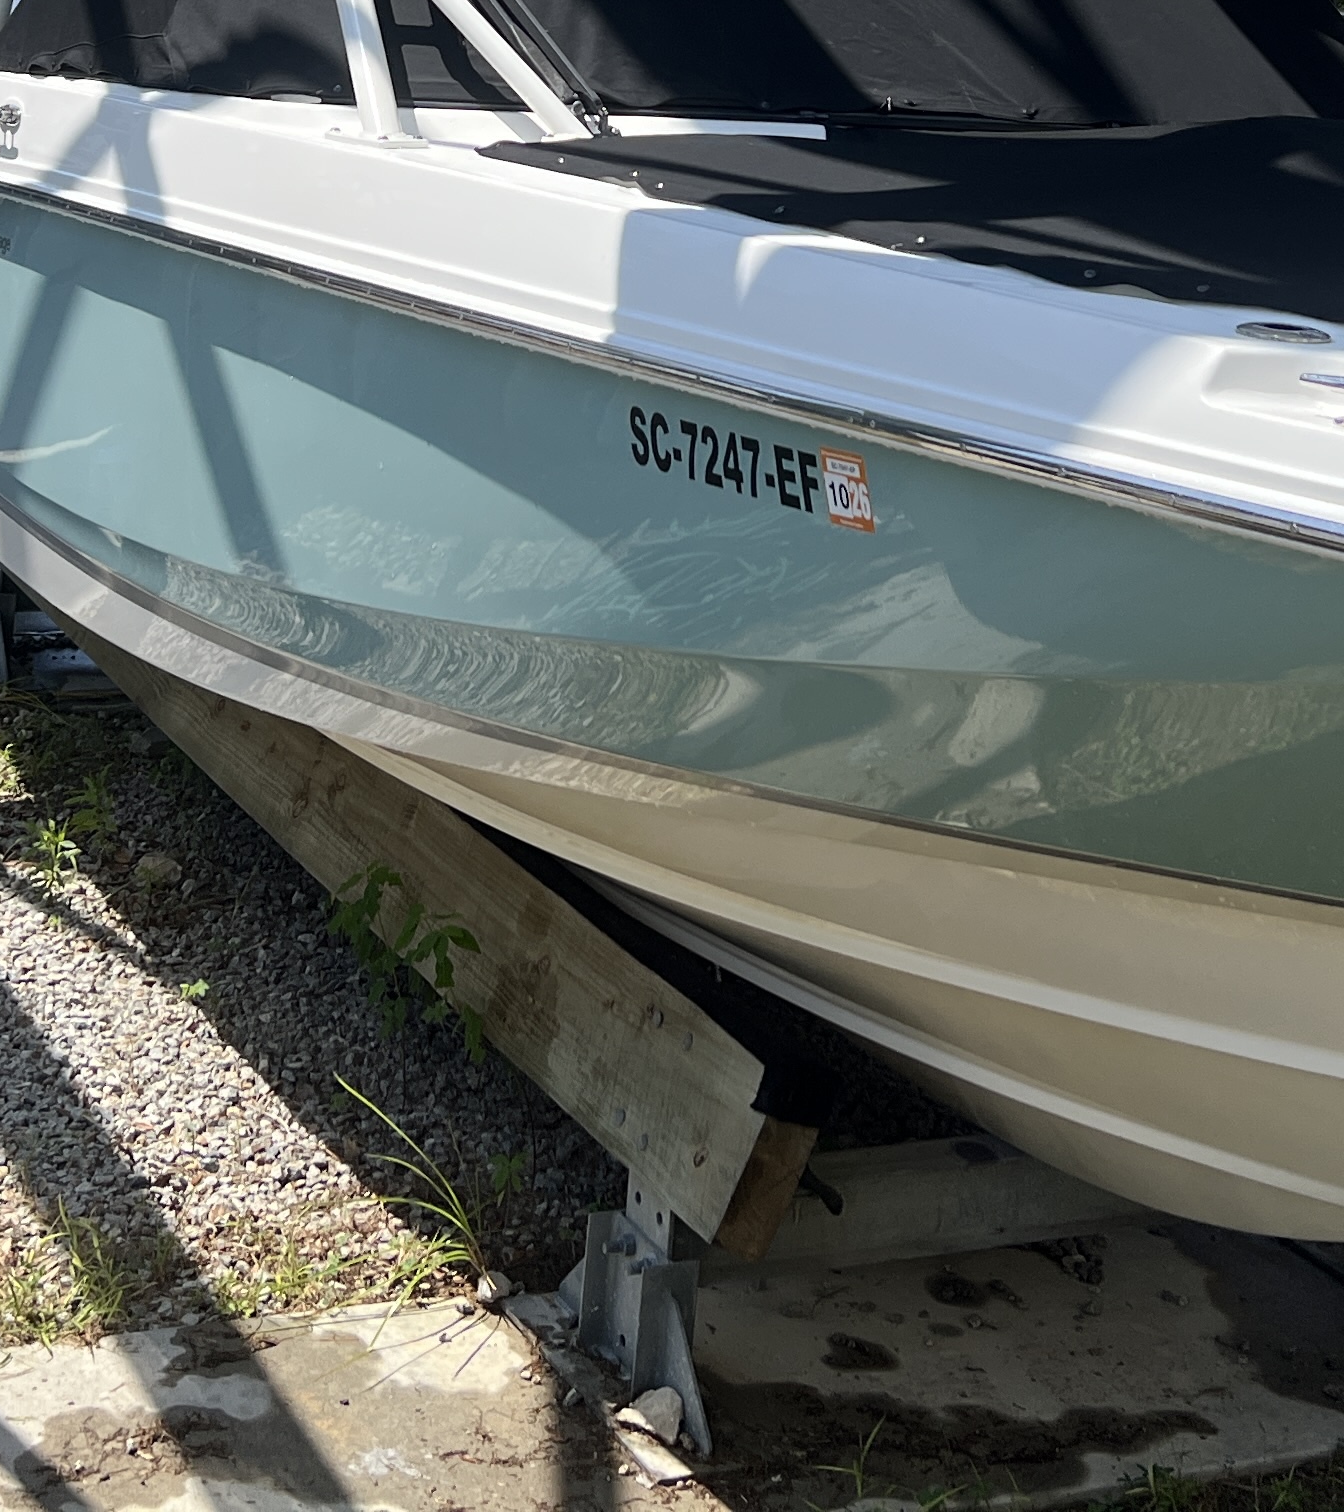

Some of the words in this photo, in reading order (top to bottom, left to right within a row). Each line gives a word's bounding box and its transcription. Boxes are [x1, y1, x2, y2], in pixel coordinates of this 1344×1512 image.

[630, 405, 819, 514] SC-7247-EF
[829, 480, 849, 509] 10
[849, 480, 872, 521] 26
